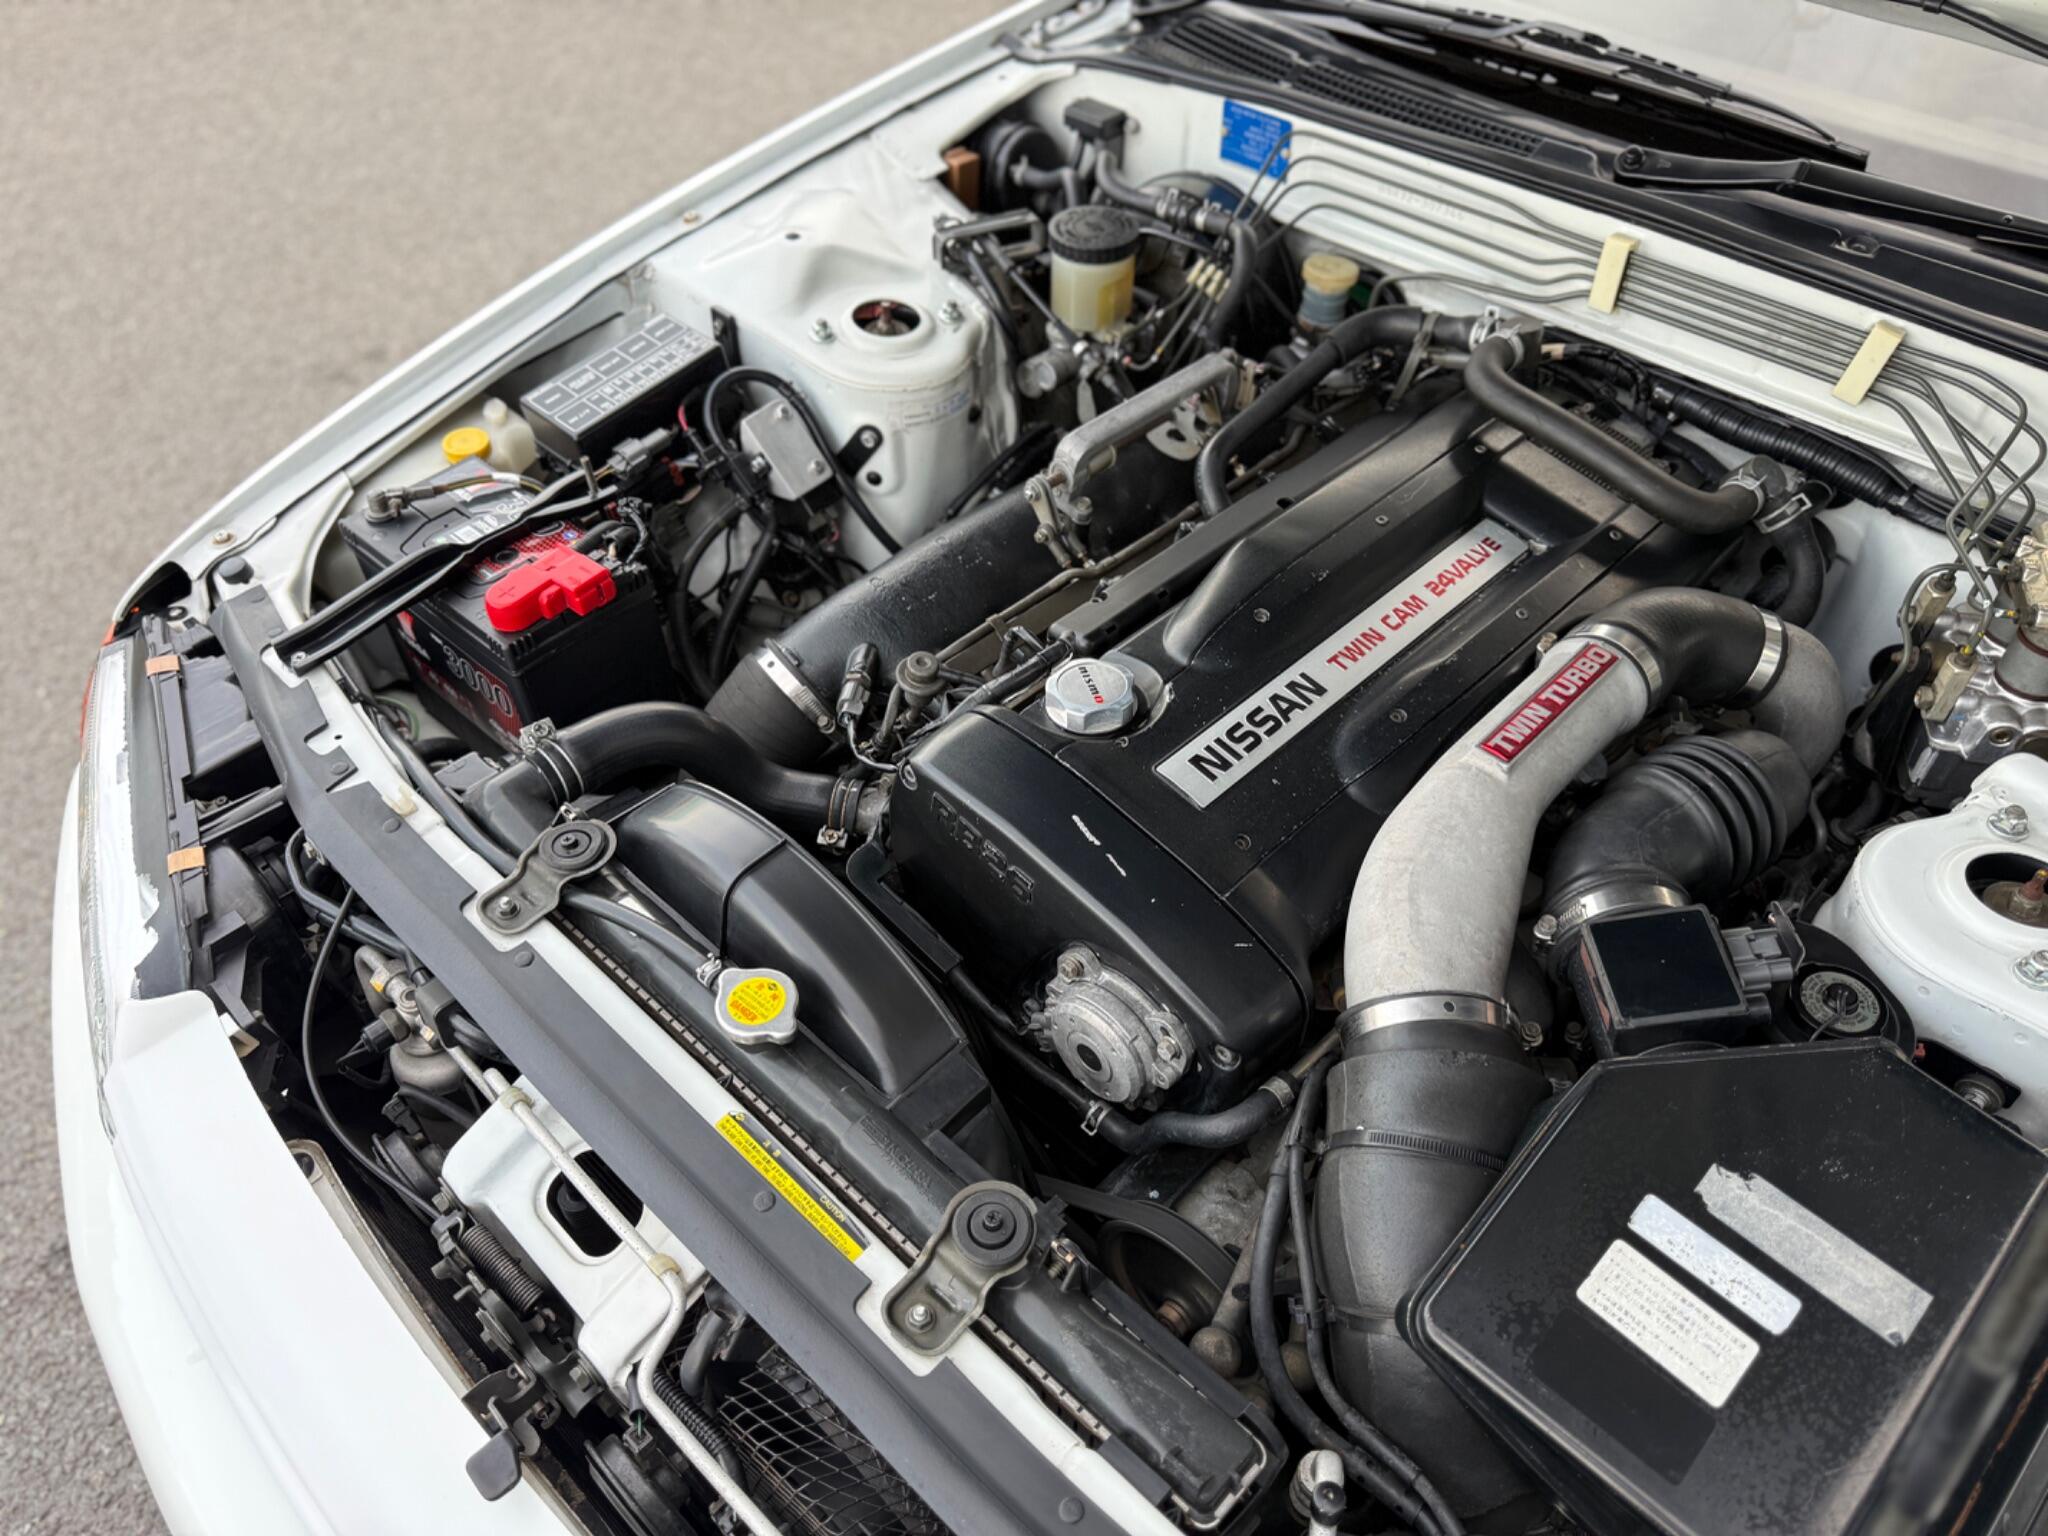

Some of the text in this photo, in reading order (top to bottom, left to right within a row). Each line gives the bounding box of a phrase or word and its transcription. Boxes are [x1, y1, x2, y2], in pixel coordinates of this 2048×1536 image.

[443, 645, 513, 718] 3000
[1187, 536, 1504, 783] NISSAN TWIN CAM 24VALVE
[1486, 644, 1613, 753] TWIN TURBO
[819, 1194, 847, 1223] CAUTION
